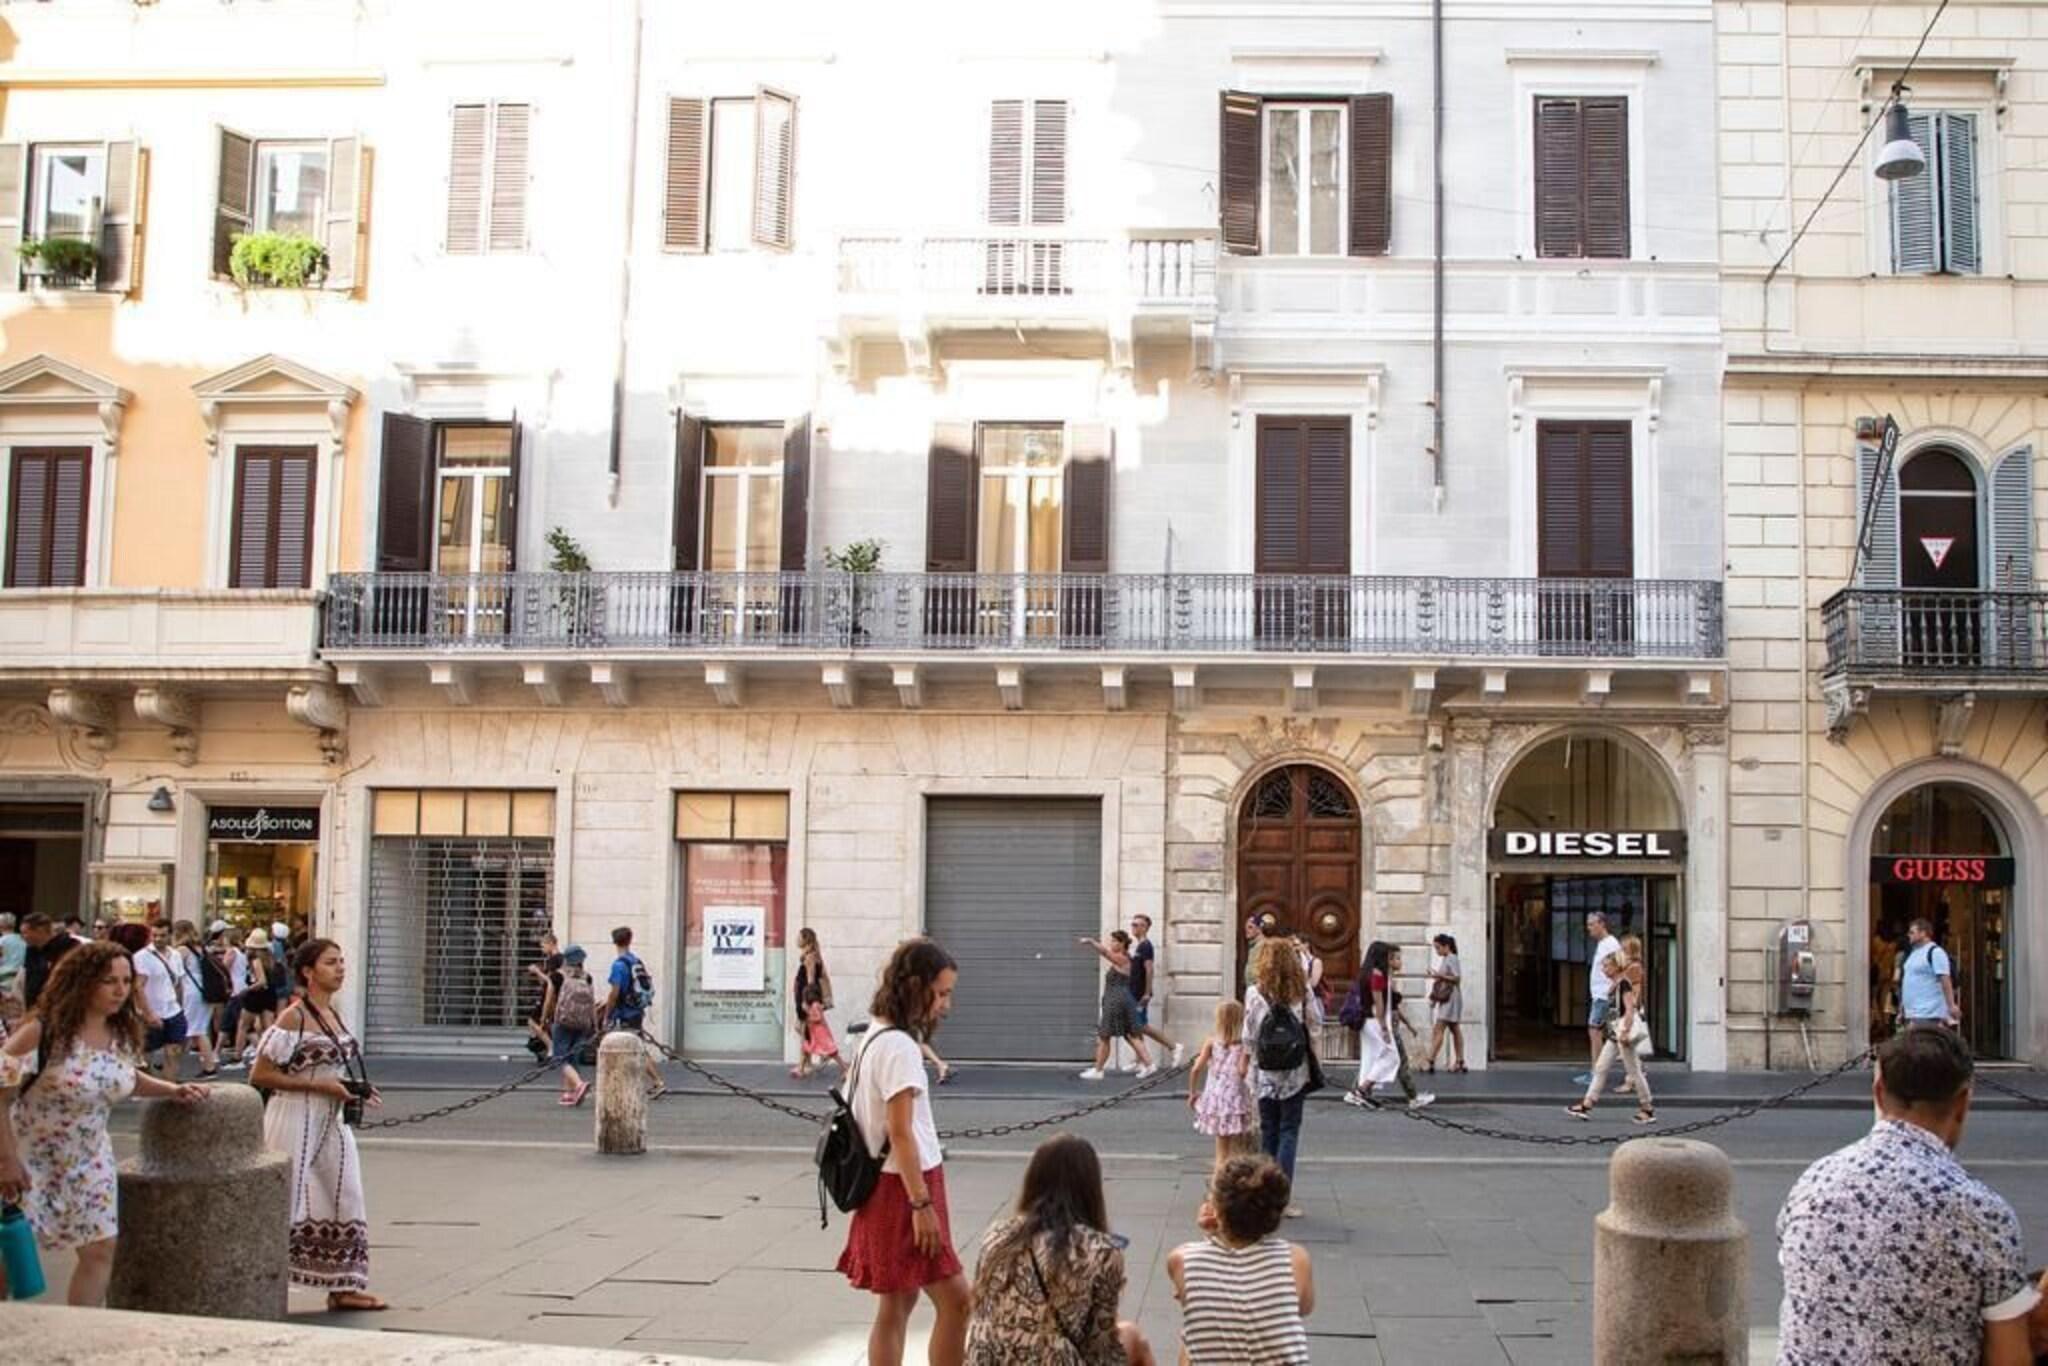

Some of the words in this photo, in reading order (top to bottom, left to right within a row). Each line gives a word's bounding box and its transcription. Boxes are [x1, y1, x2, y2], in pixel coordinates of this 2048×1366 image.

[210, 818, 250, 830] ASOLE
[260, 818, 313, 830] BOTTONI
[1505, 832, 1671, 855] DIESEL
[1893, 859, 1985, 880] GUESS
